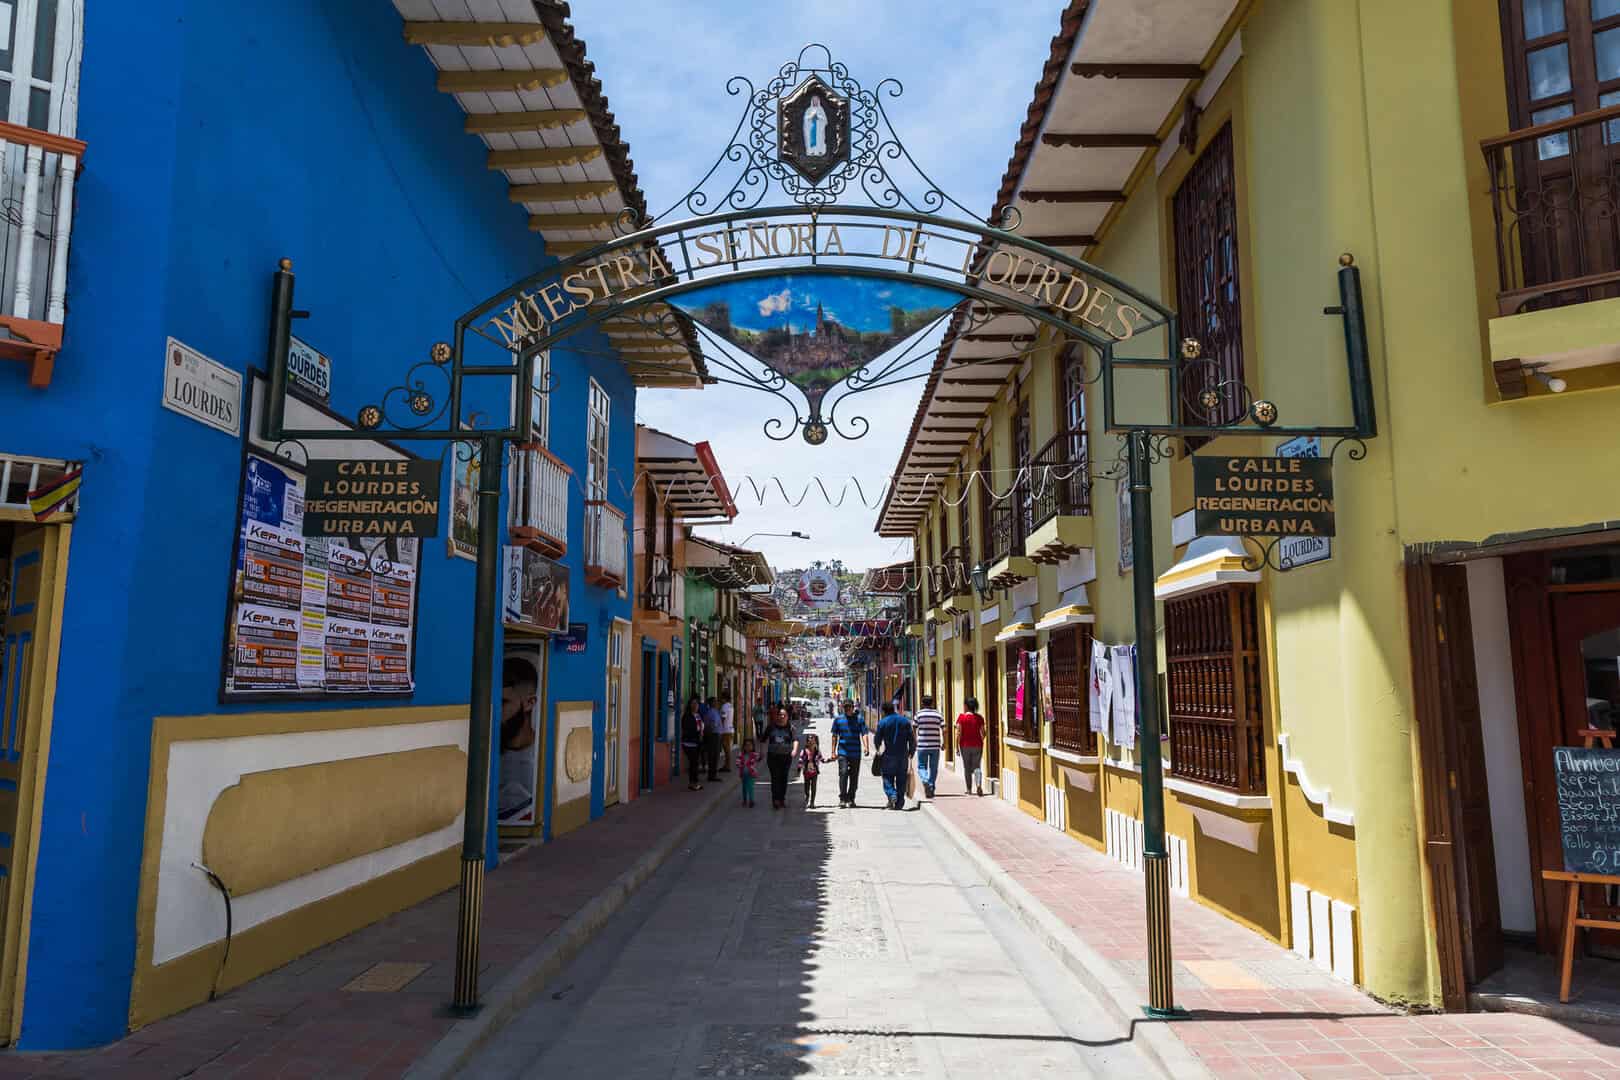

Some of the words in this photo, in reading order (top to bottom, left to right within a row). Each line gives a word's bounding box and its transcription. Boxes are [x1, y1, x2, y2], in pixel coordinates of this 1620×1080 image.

[490, 247, 675, 347] NUESTRA
[880, 224, 931, 263] DE
[961, 241, 1142, 341] LOURDES
[288, 351, 328, 389] OURDES
[173, 377, 233, 423] LOURDES
[338, 462, 408, 475] CALLE
[1228, 459, 1301, 473] CALLE
[323, 480, 420, 495] LOURDES
[1216, 477, 1315, 492] LOURDES
[304, 495, 438, 514] REGENERACIÓN
[1197, 493, 1334, 512] REGENERACIÓN
[323, 520, 415, 534] URBANA
[1220, 518, 1315, 533] URBANA
[1283, 537, 1324, 558] LOURDES
